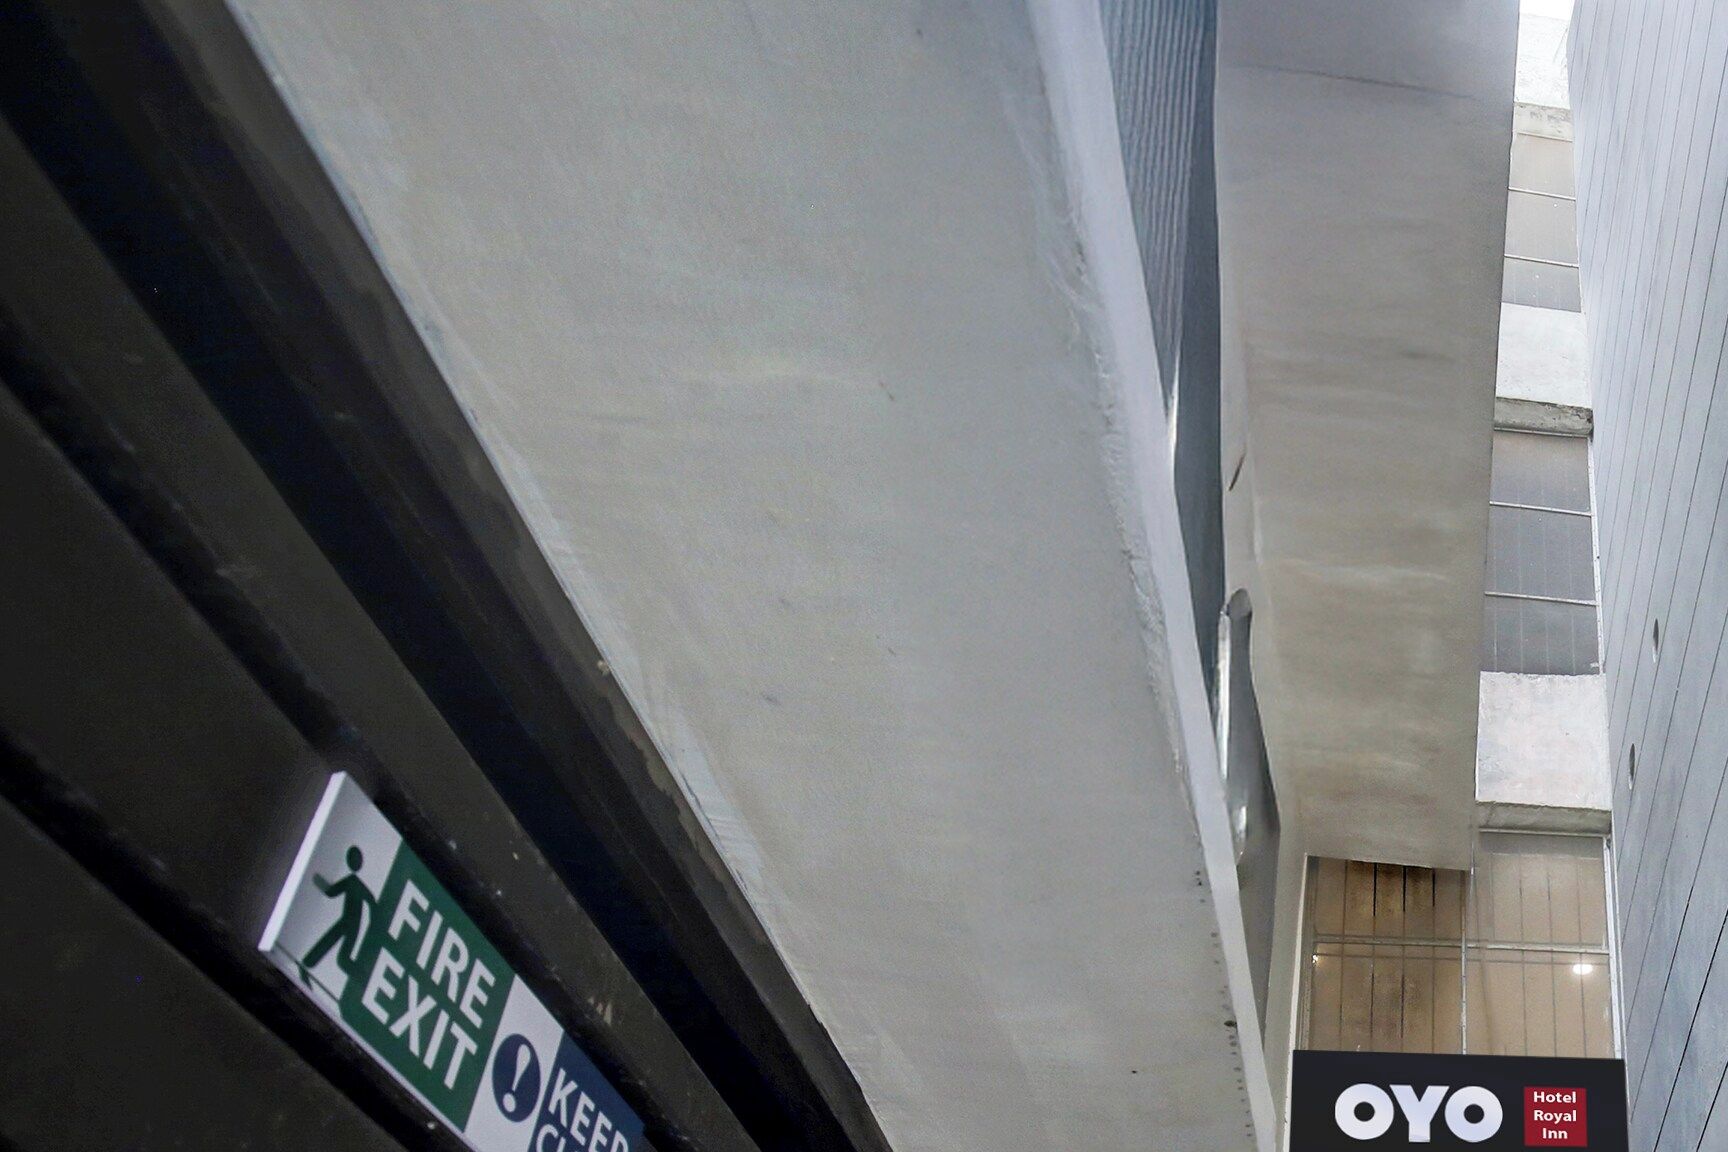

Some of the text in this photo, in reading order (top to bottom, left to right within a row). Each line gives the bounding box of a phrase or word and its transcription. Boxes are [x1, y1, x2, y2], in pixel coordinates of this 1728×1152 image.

[387, 879, 496, 1029] FIRE
[361, 946, 478, 1090] EXIT
[1335, 1083, 1503, 1143] OYO
[1533, 1091, 1577, 1103] Hotel
[1533, 1109, 1577, 1125] Royal
[1542, 1127, 1568, 1139] Inn
